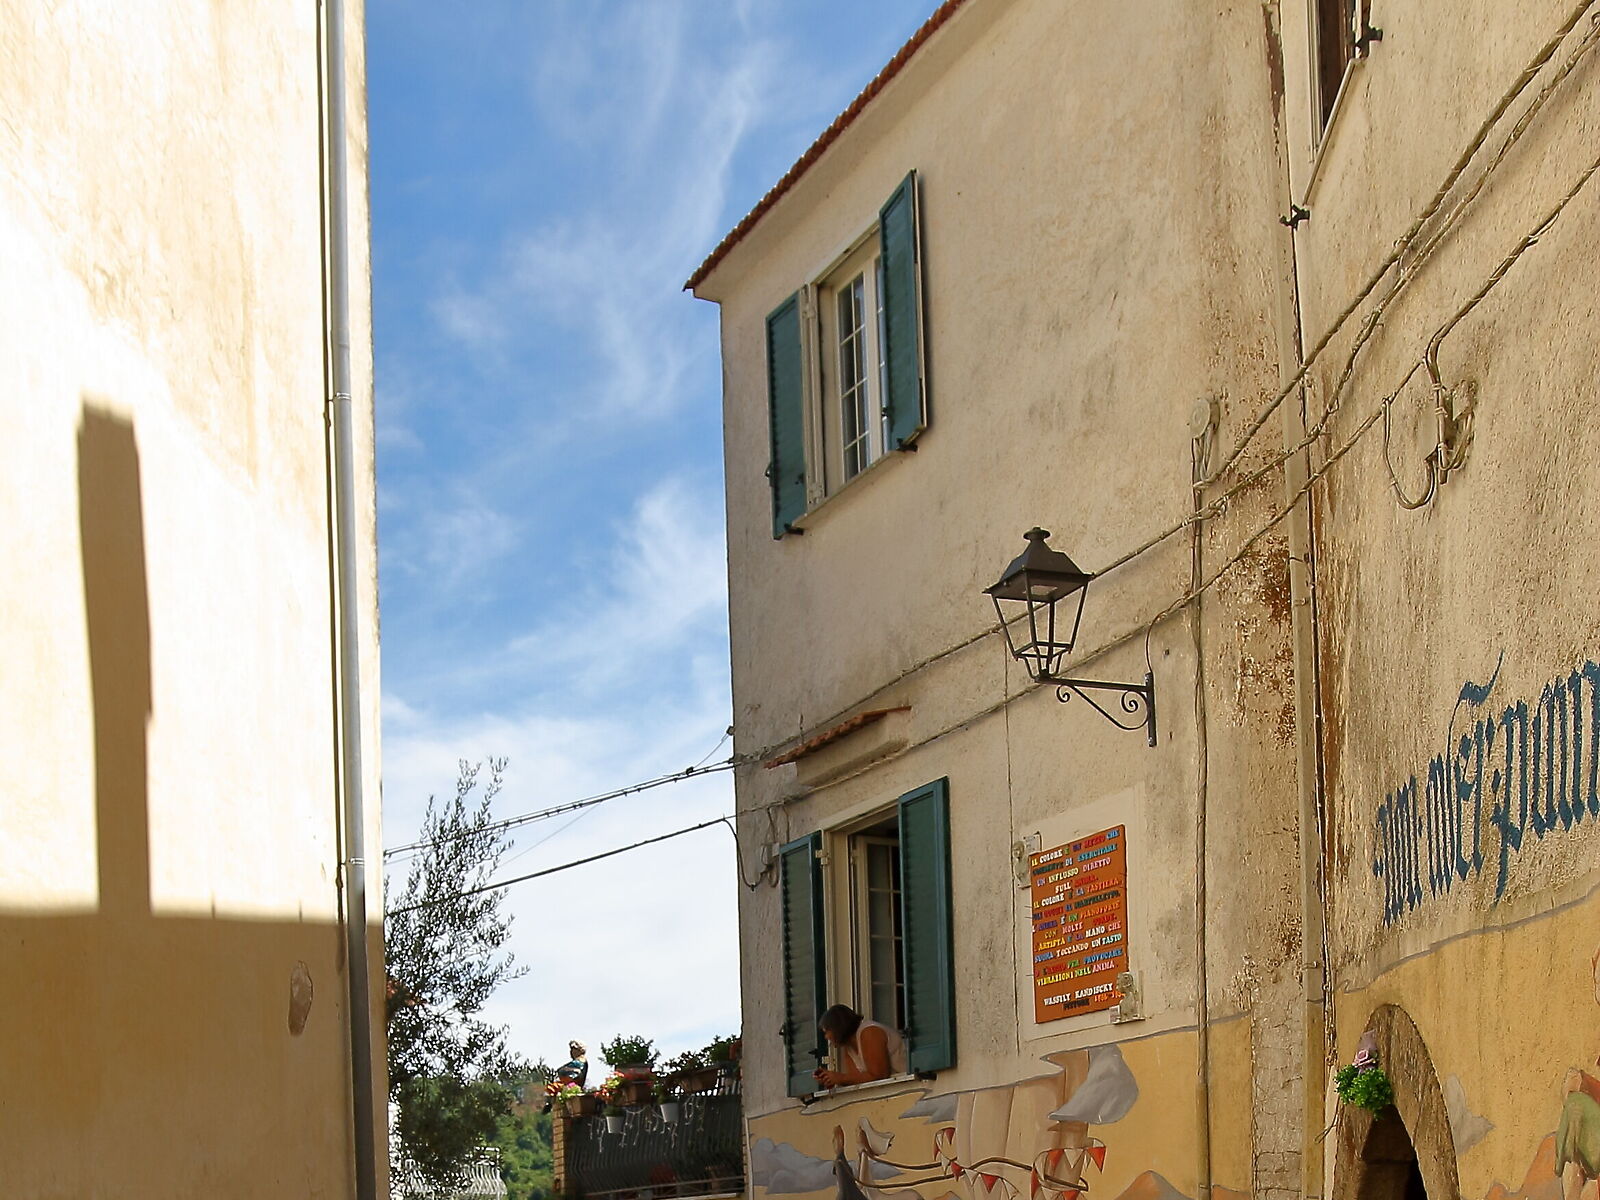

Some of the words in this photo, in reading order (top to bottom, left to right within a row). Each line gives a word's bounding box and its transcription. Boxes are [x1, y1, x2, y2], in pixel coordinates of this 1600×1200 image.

[1040, 849, 1062, 863] COLORE
[1049, 867, 1079, 884] INFLUSSO
[1082, 857, 1110, 872] DIRETTO
[1042, 893, 1064, 907] COLORE
[1062, 921, 1083, 934] MOLTE
[1086, 926, 1105, 938] MANO
[1056, 941, 1088, 958] TOCCANDO
[1102, 933, 1121, 945] TASTO
[1044, 993, 1070, 1006] WASSILY
